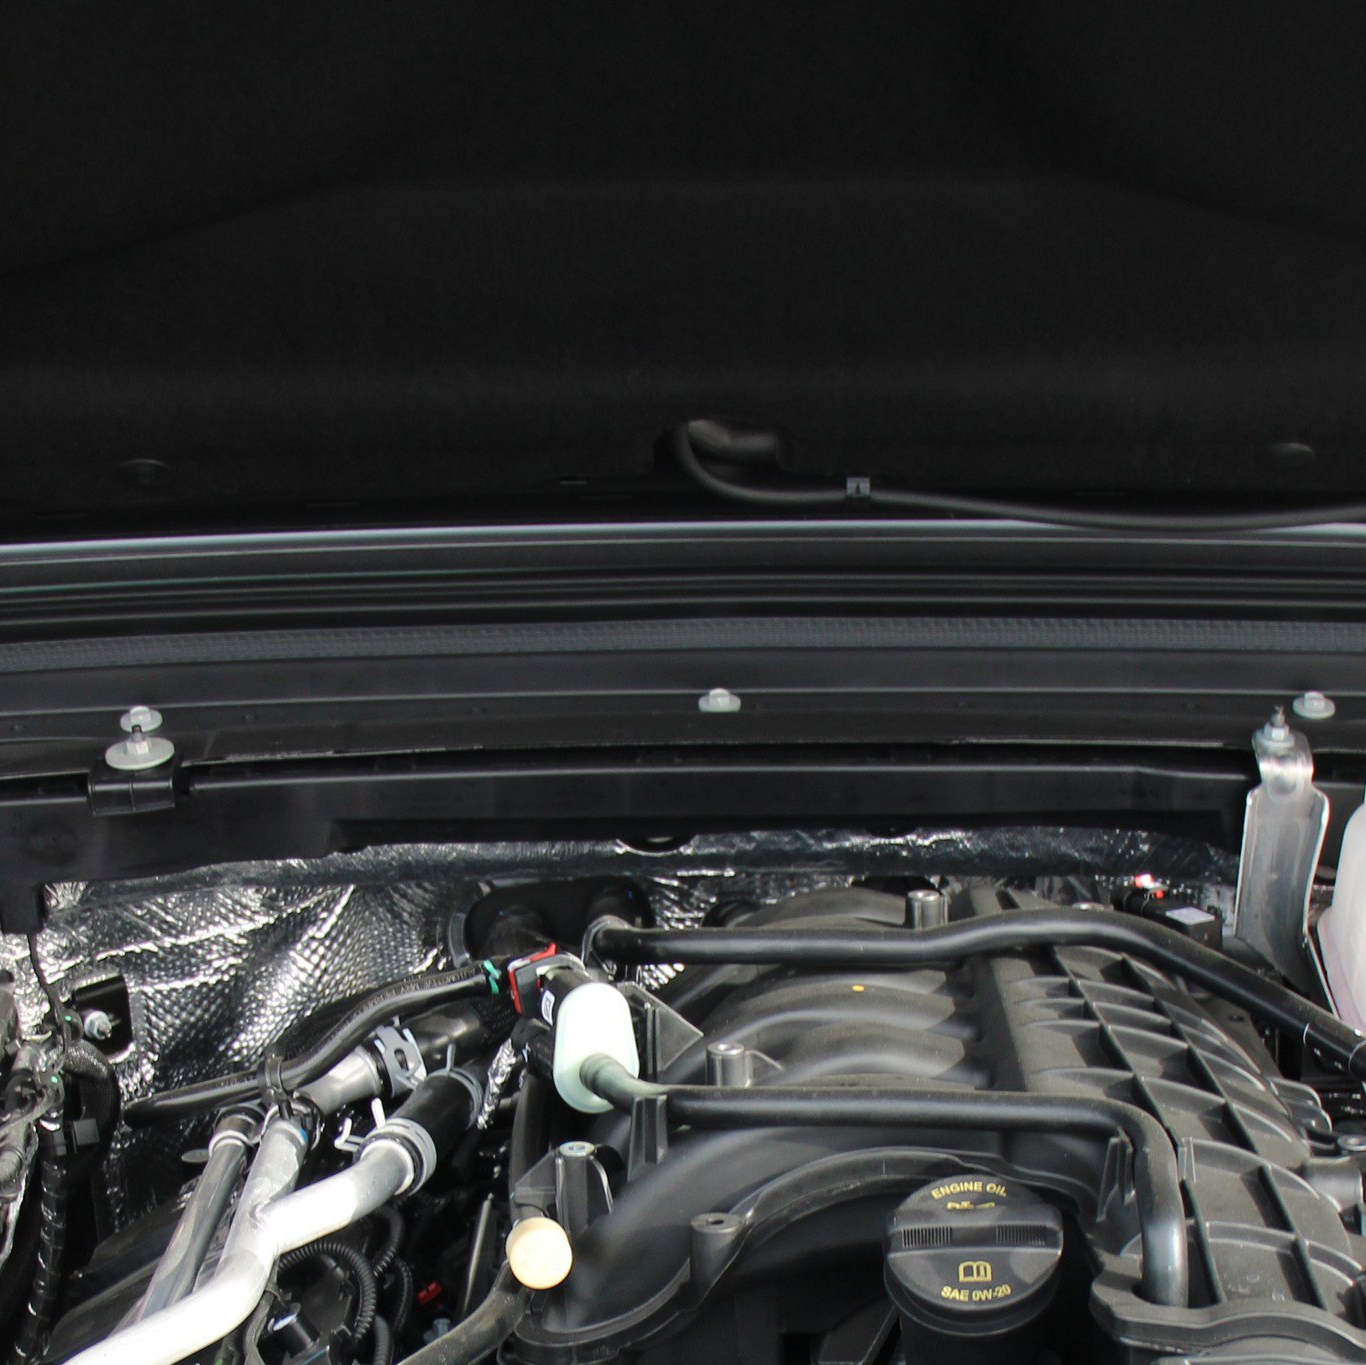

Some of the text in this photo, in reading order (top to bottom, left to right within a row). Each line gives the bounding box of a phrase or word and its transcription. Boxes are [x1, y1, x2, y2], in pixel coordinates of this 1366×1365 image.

[931, 1181, 1008, 1200] ENGINE OIL
[941, 1284, 1011, 1302] SAE 0W-20
